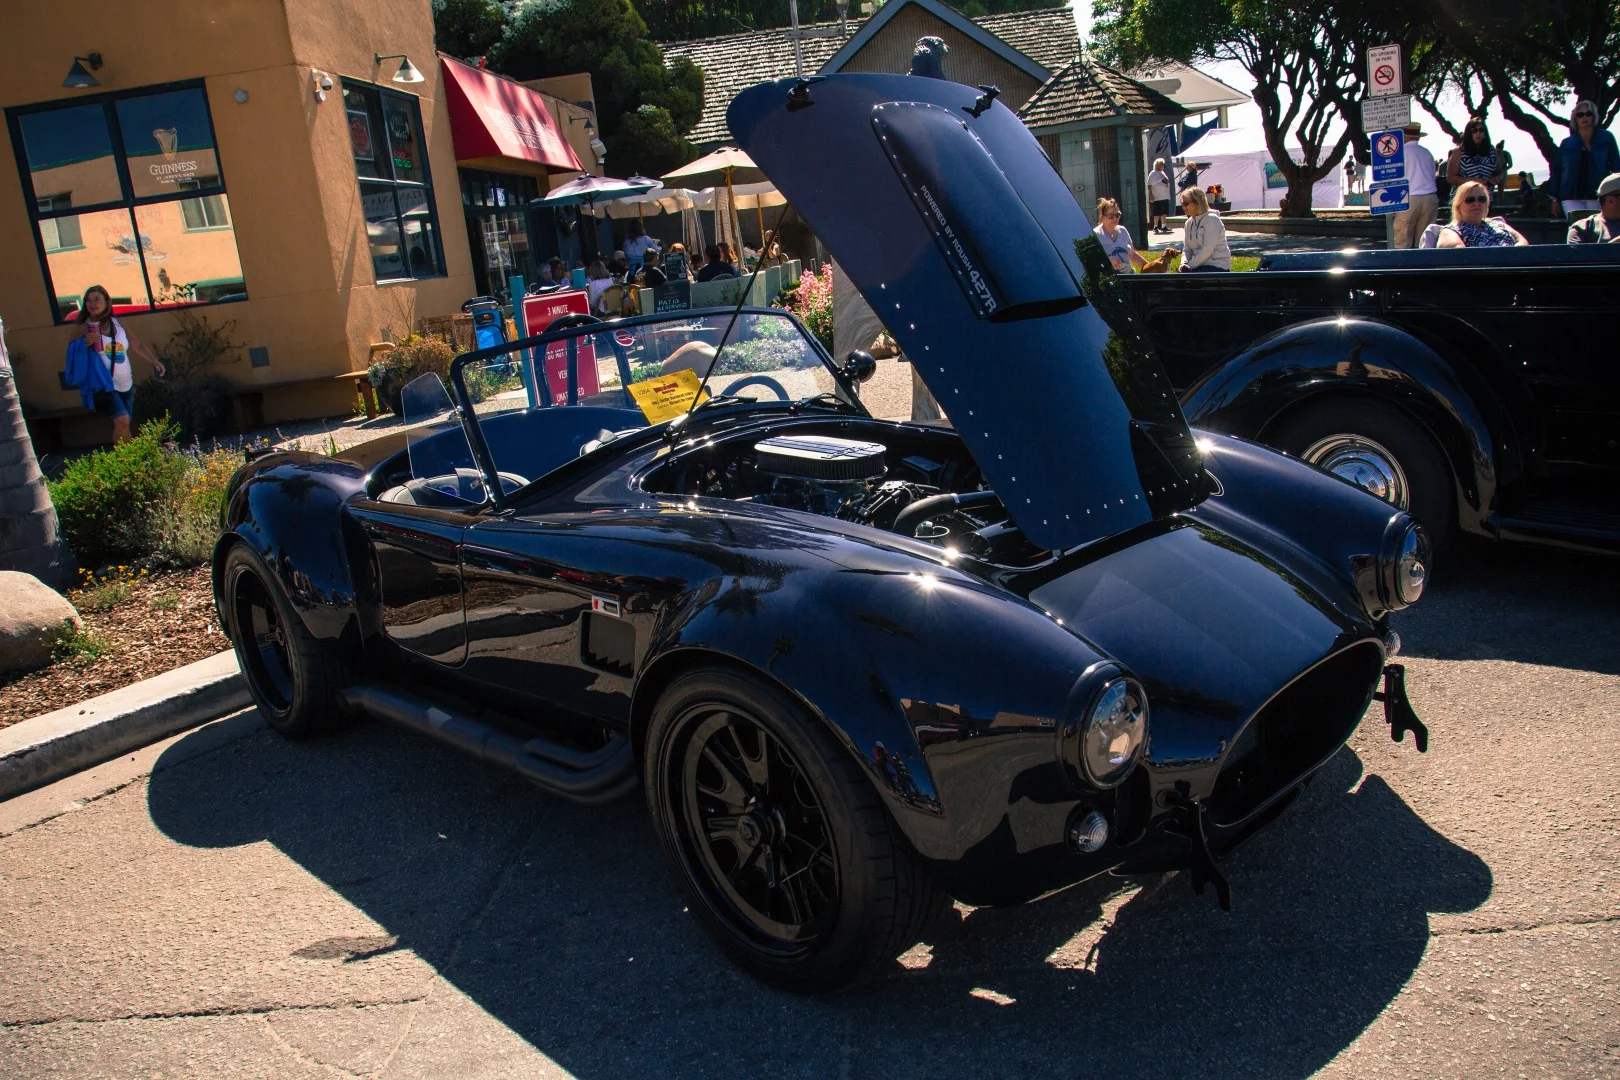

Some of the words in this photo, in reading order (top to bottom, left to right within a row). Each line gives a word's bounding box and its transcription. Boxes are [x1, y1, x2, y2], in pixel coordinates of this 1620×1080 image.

[150, 161, 197, 175] GUINNESS
[1374, 162, 1404, 170] SKATEBOARDING
[920, 185, 946, 226] POWERED
[944, 226, 954, 238] BY
[952, 239, 973, 271] ROUSH
[970, 270, 997, 313] 427R
[547, 307, 551, 315] 3
[552, 304, 568, 315] MINUTE
